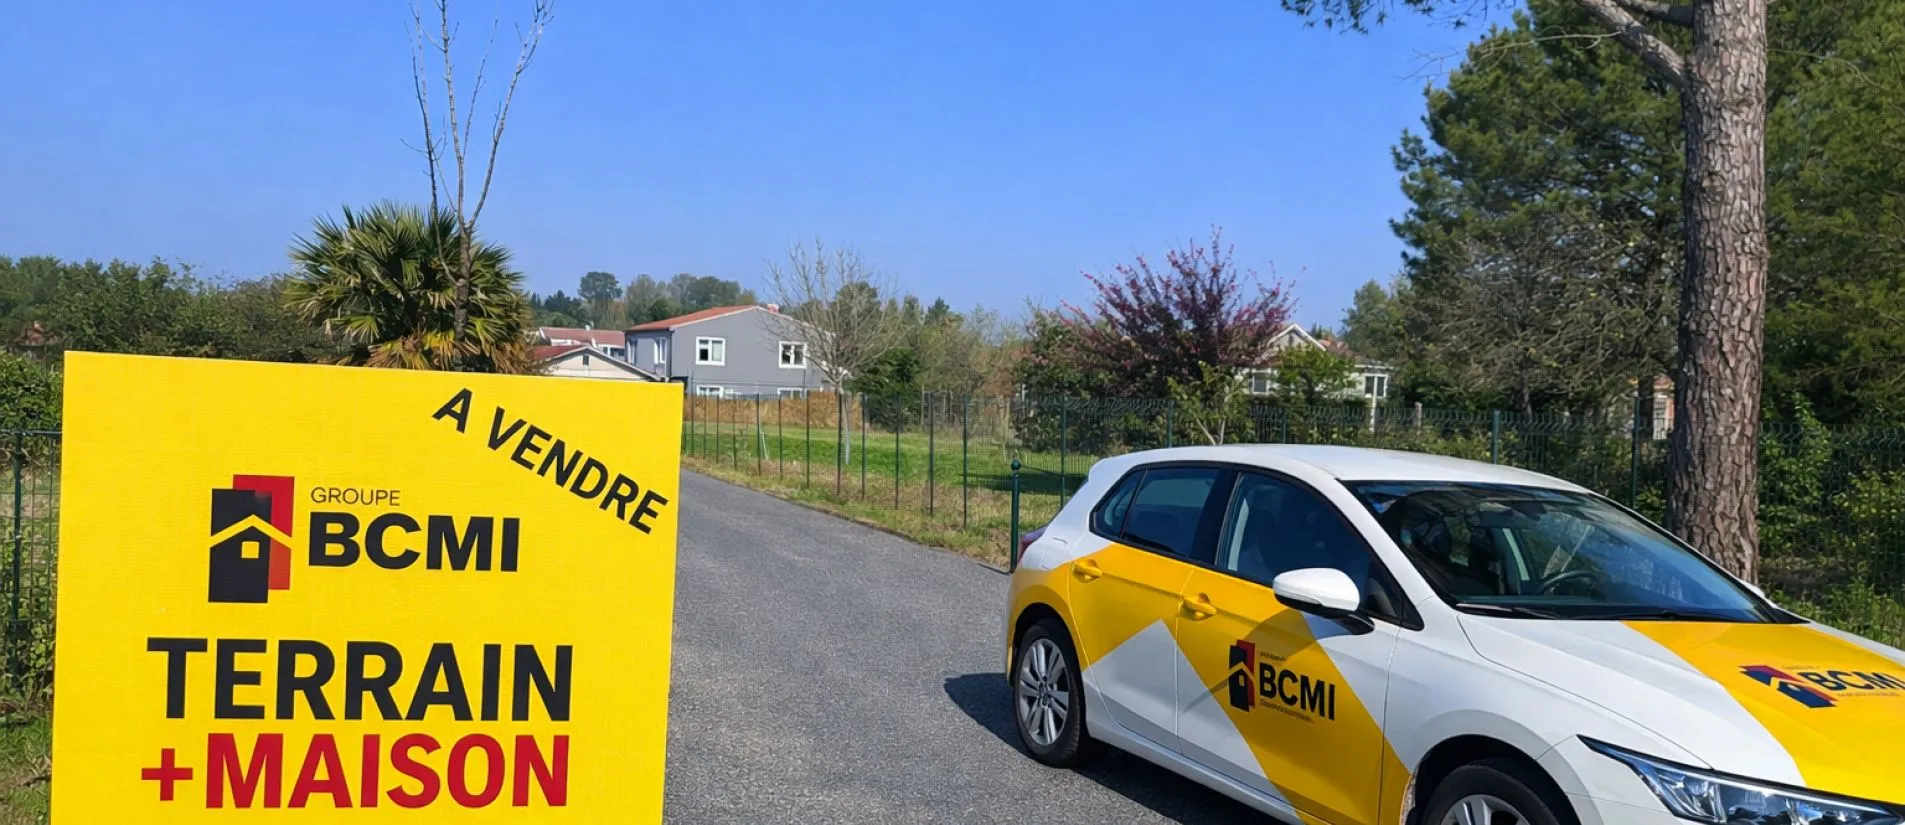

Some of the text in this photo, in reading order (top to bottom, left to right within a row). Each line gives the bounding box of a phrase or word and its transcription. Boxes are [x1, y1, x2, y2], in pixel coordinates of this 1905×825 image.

[431, 387, 669, 535] A VENDRE
[310, 486, 401, 506] GROUPE
[308, 511, 520, 573] BCMI
[146, 637, 574, 722] TERRAIN
[1259, 661, 1336, 721] BCMI
